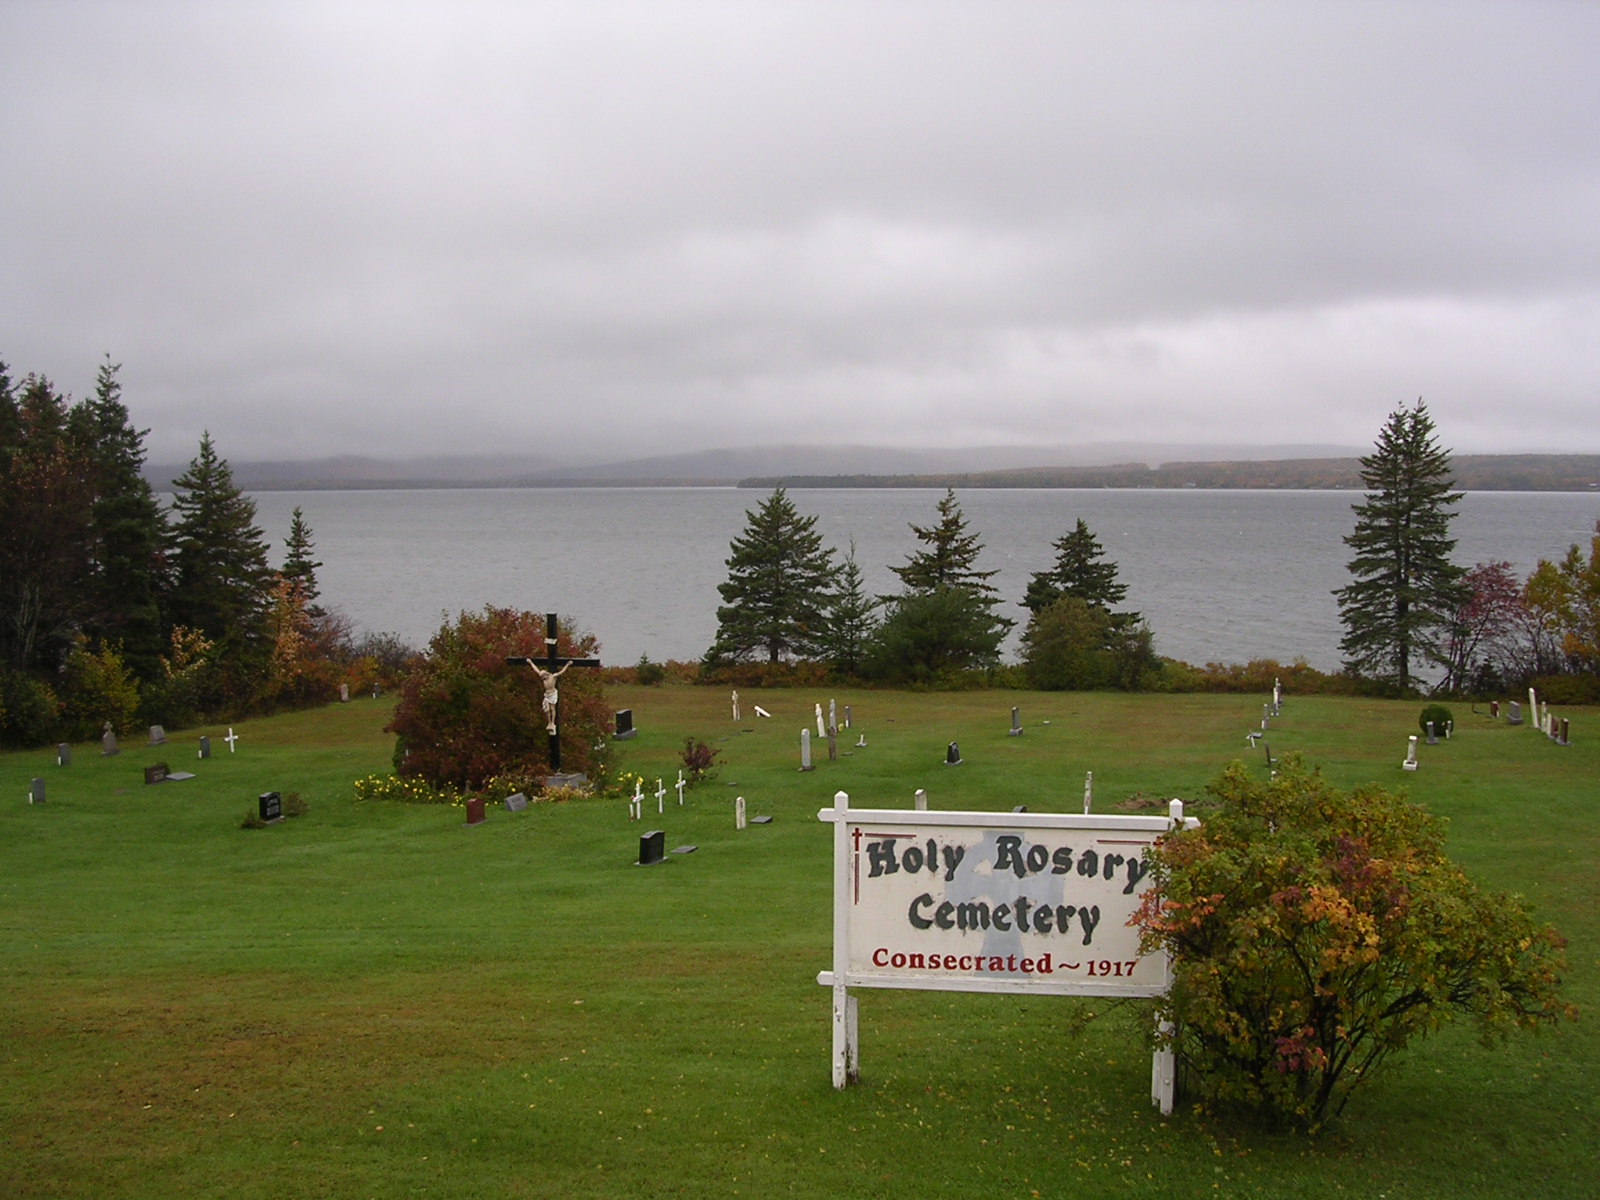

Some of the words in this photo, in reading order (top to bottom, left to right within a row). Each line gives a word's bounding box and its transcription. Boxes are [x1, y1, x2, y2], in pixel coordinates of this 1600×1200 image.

[866, 838, 964, 881] Holy
[994, 835, 1151, 894] Rosary
[908, 893, 1100, 945] Cemetery
[872, 948, 1053, 974] Consecrated
[1087, 960, 1137, 977] 1917
